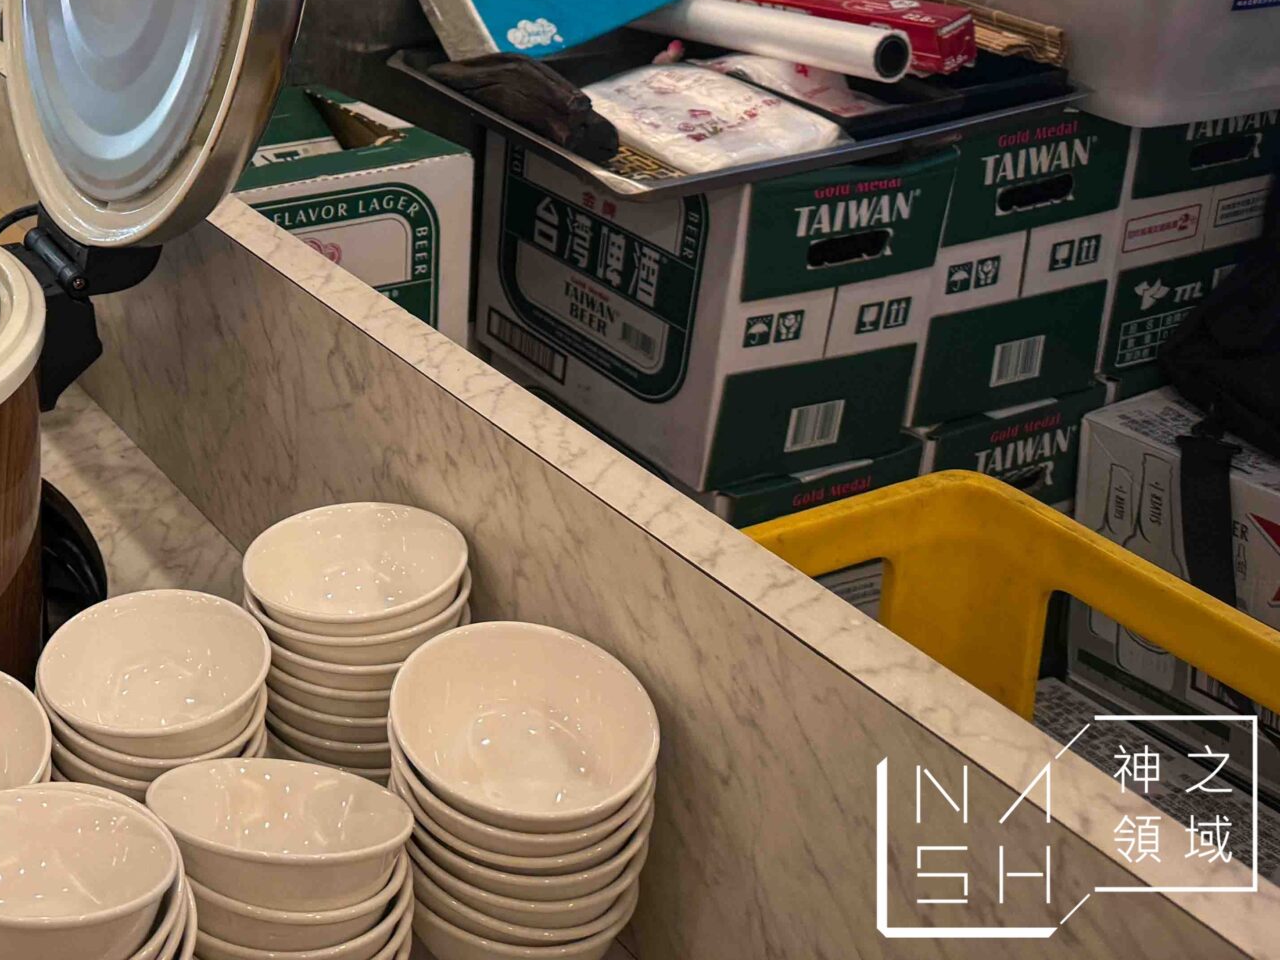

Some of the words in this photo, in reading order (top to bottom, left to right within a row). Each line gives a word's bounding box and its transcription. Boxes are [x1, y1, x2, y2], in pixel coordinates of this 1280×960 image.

[997, 130, 1030, 148] Gold
[1034, 120, 1079, 139] Medal
[980, 136, 1092, 186] TAIWAN
[274, 202, 348, 227] FLAVOR
[358, 194, 420, 218] LAGER
[414, 226, 429, 275] BEER
[682, 211, 701, 261] BEER
[794, 189, 916, 237] TAIWAN
[563, 279, 616, 324] TAIWAN
[569, 301, 608, 338] BEER
[974, 425, 1071, 474] TAIWAN
[792, 487, 825, 508] Gold
[831, 474, 872, 497] Medal
